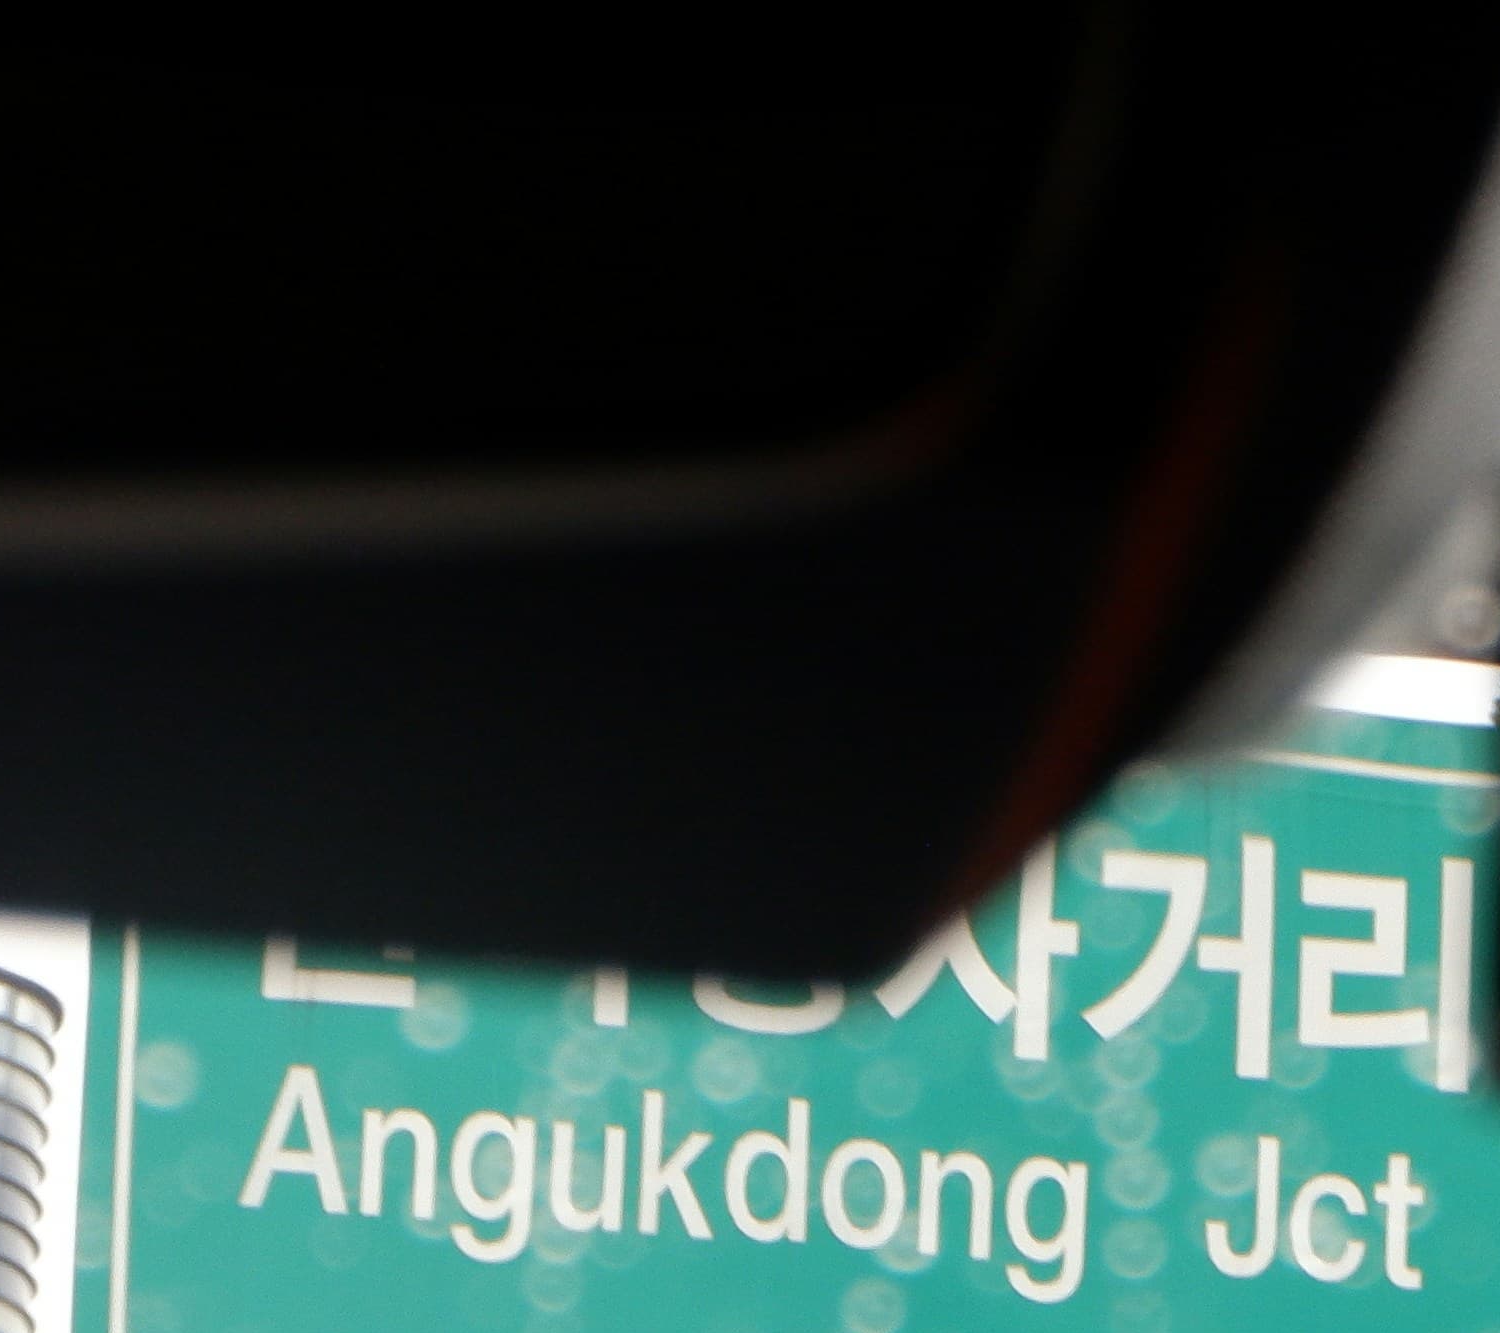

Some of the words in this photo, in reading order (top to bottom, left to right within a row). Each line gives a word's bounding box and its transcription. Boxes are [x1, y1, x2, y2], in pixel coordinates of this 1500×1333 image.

[260, 832, 1475, 1093] 사거리
[238, 1063, 1090, 1304] Angukdong
[1203, 1134, 1428, 1290] Jct
